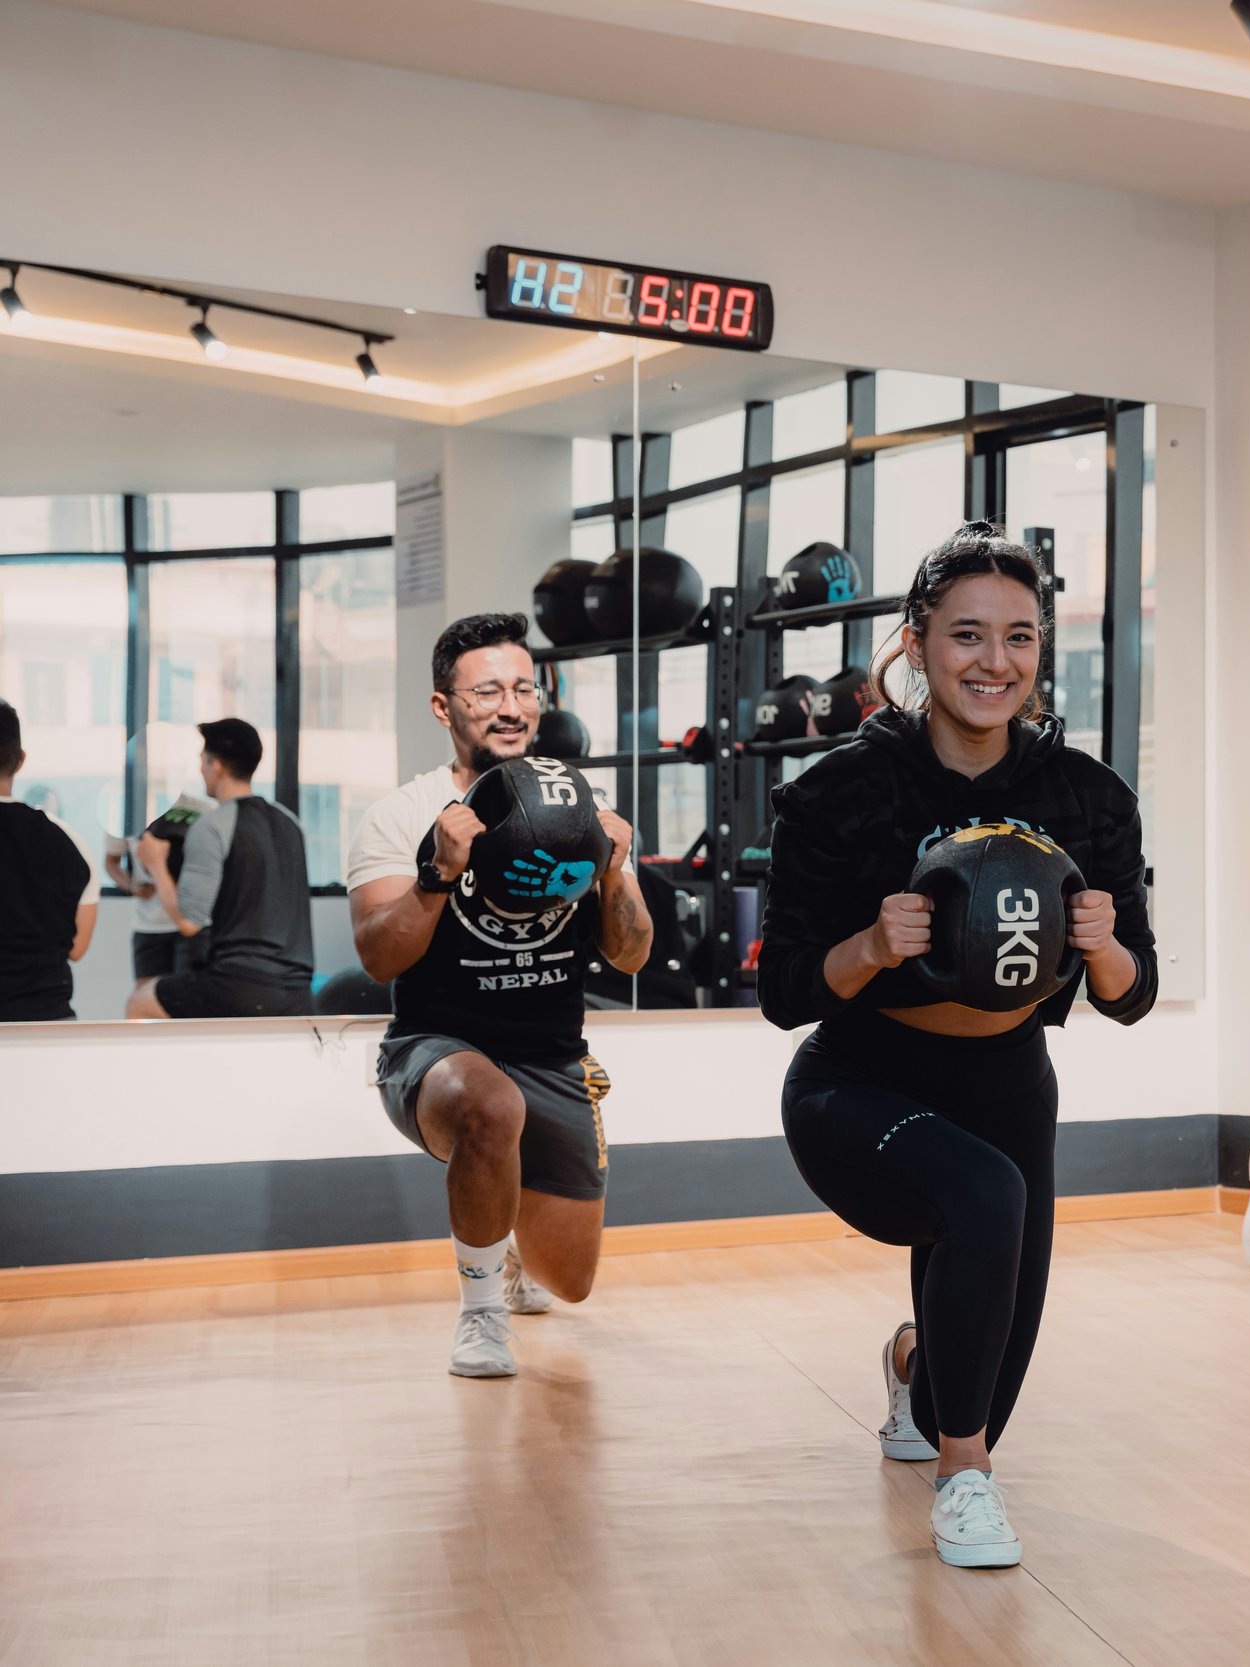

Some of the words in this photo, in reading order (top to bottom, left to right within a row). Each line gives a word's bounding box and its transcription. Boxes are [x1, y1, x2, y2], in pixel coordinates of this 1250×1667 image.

[638, 275, 755, 337] 5:00
[524, 756, 578, 807] 5KG
[515, 952, 534, 967] 65
[994, 888, 1039, 987] 3KG
[477, 968, 568, 990] NEPAL
